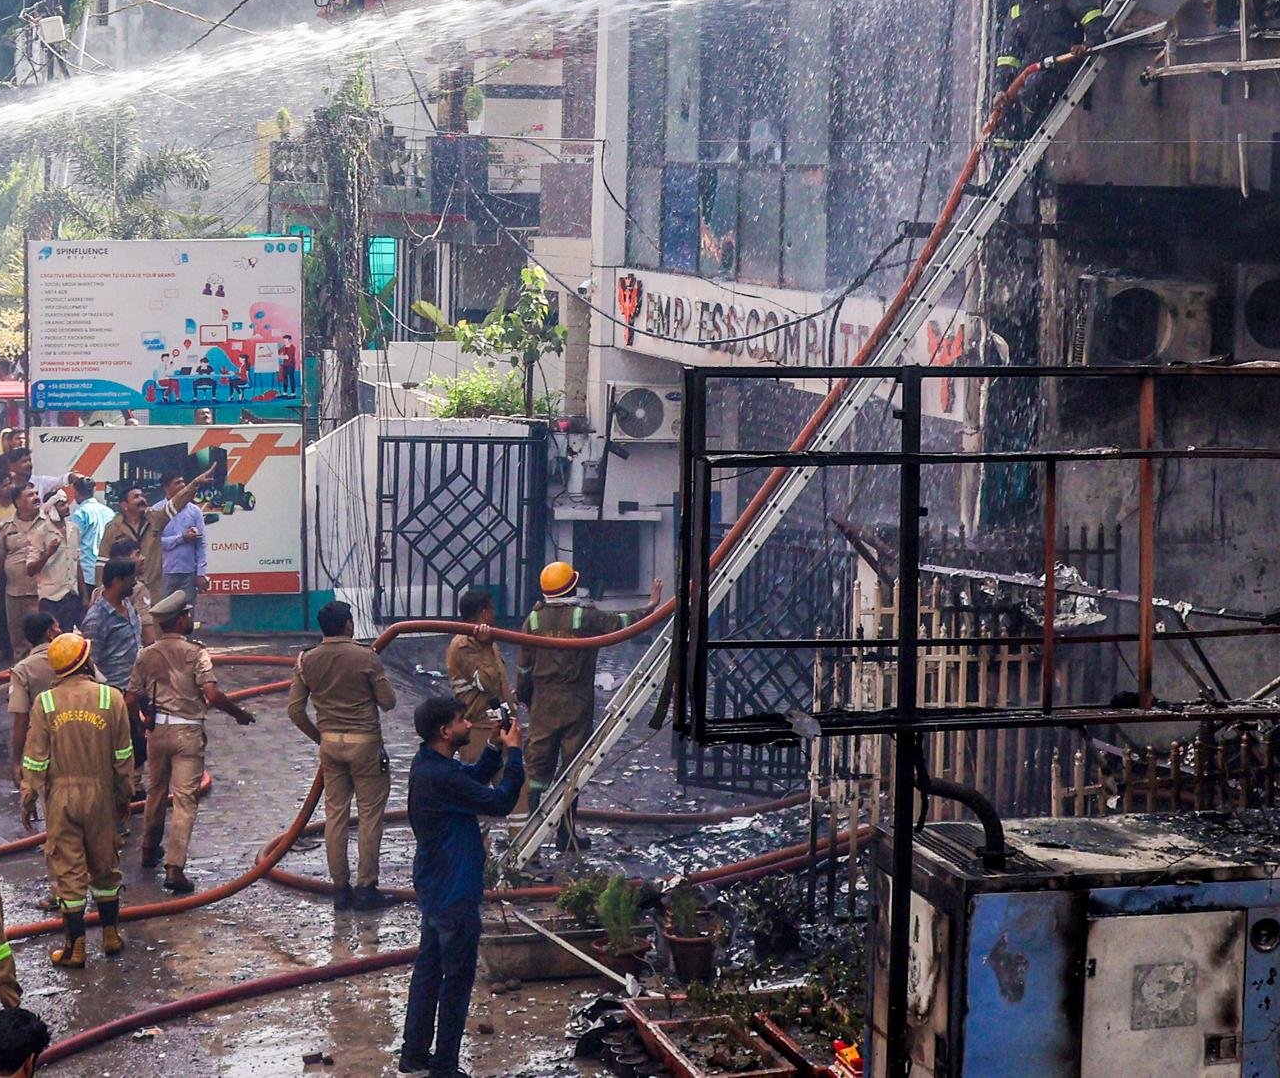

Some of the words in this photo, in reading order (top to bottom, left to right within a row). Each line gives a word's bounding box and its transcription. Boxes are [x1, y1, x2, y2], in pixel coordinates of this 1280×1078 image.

[56, 247, 109, 255] SPINFLUENCE
[211, 542, 249, 551] GAMING
[258, 558, 293, 566] GIGABYTE
